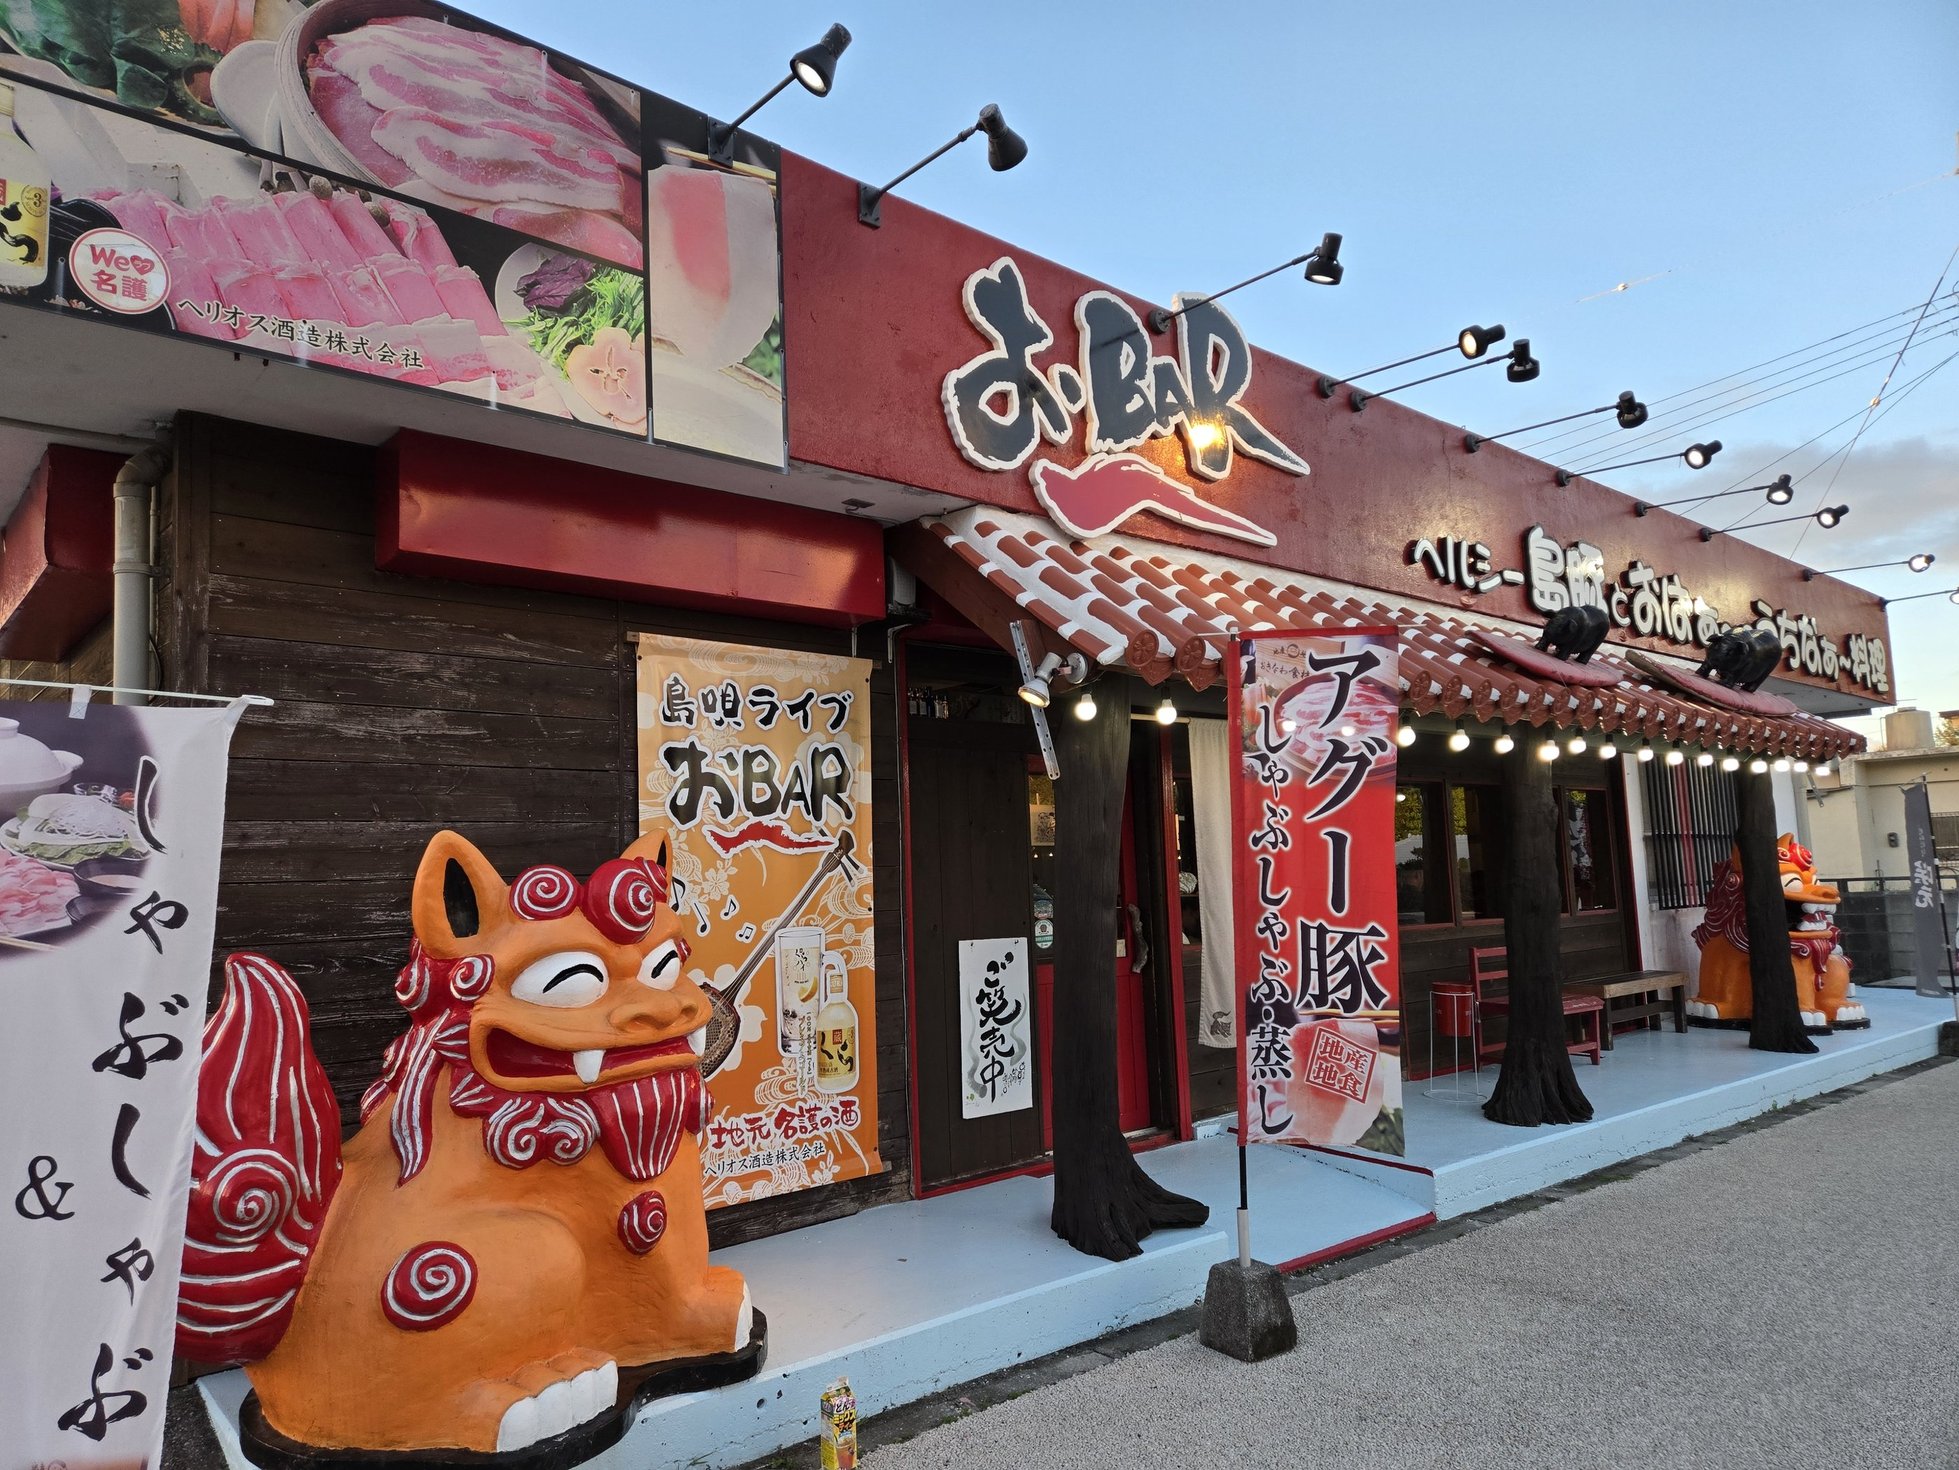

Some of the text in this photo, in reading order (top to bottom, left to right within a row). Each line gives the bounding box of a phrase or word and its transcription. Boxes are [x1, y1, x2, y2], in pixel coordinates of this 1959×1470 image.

[90, 244, 130, 272] We
[90, 269, 148, 302] 名護
[178, 299, 424, 369] ヘリオス酒造株式会社
[662, 675, 853, 731] 島唄ライブ
[663, 740, 853, 826] おBAR
[1296, 650, 1388, 1014] アグー豚
[57, 755, 188, 1442] しゃぶしゃぶ
[16, 1154, 75, 1221] &
[704, 1142, 825, 1176] ヘリオス酒造株式会社
